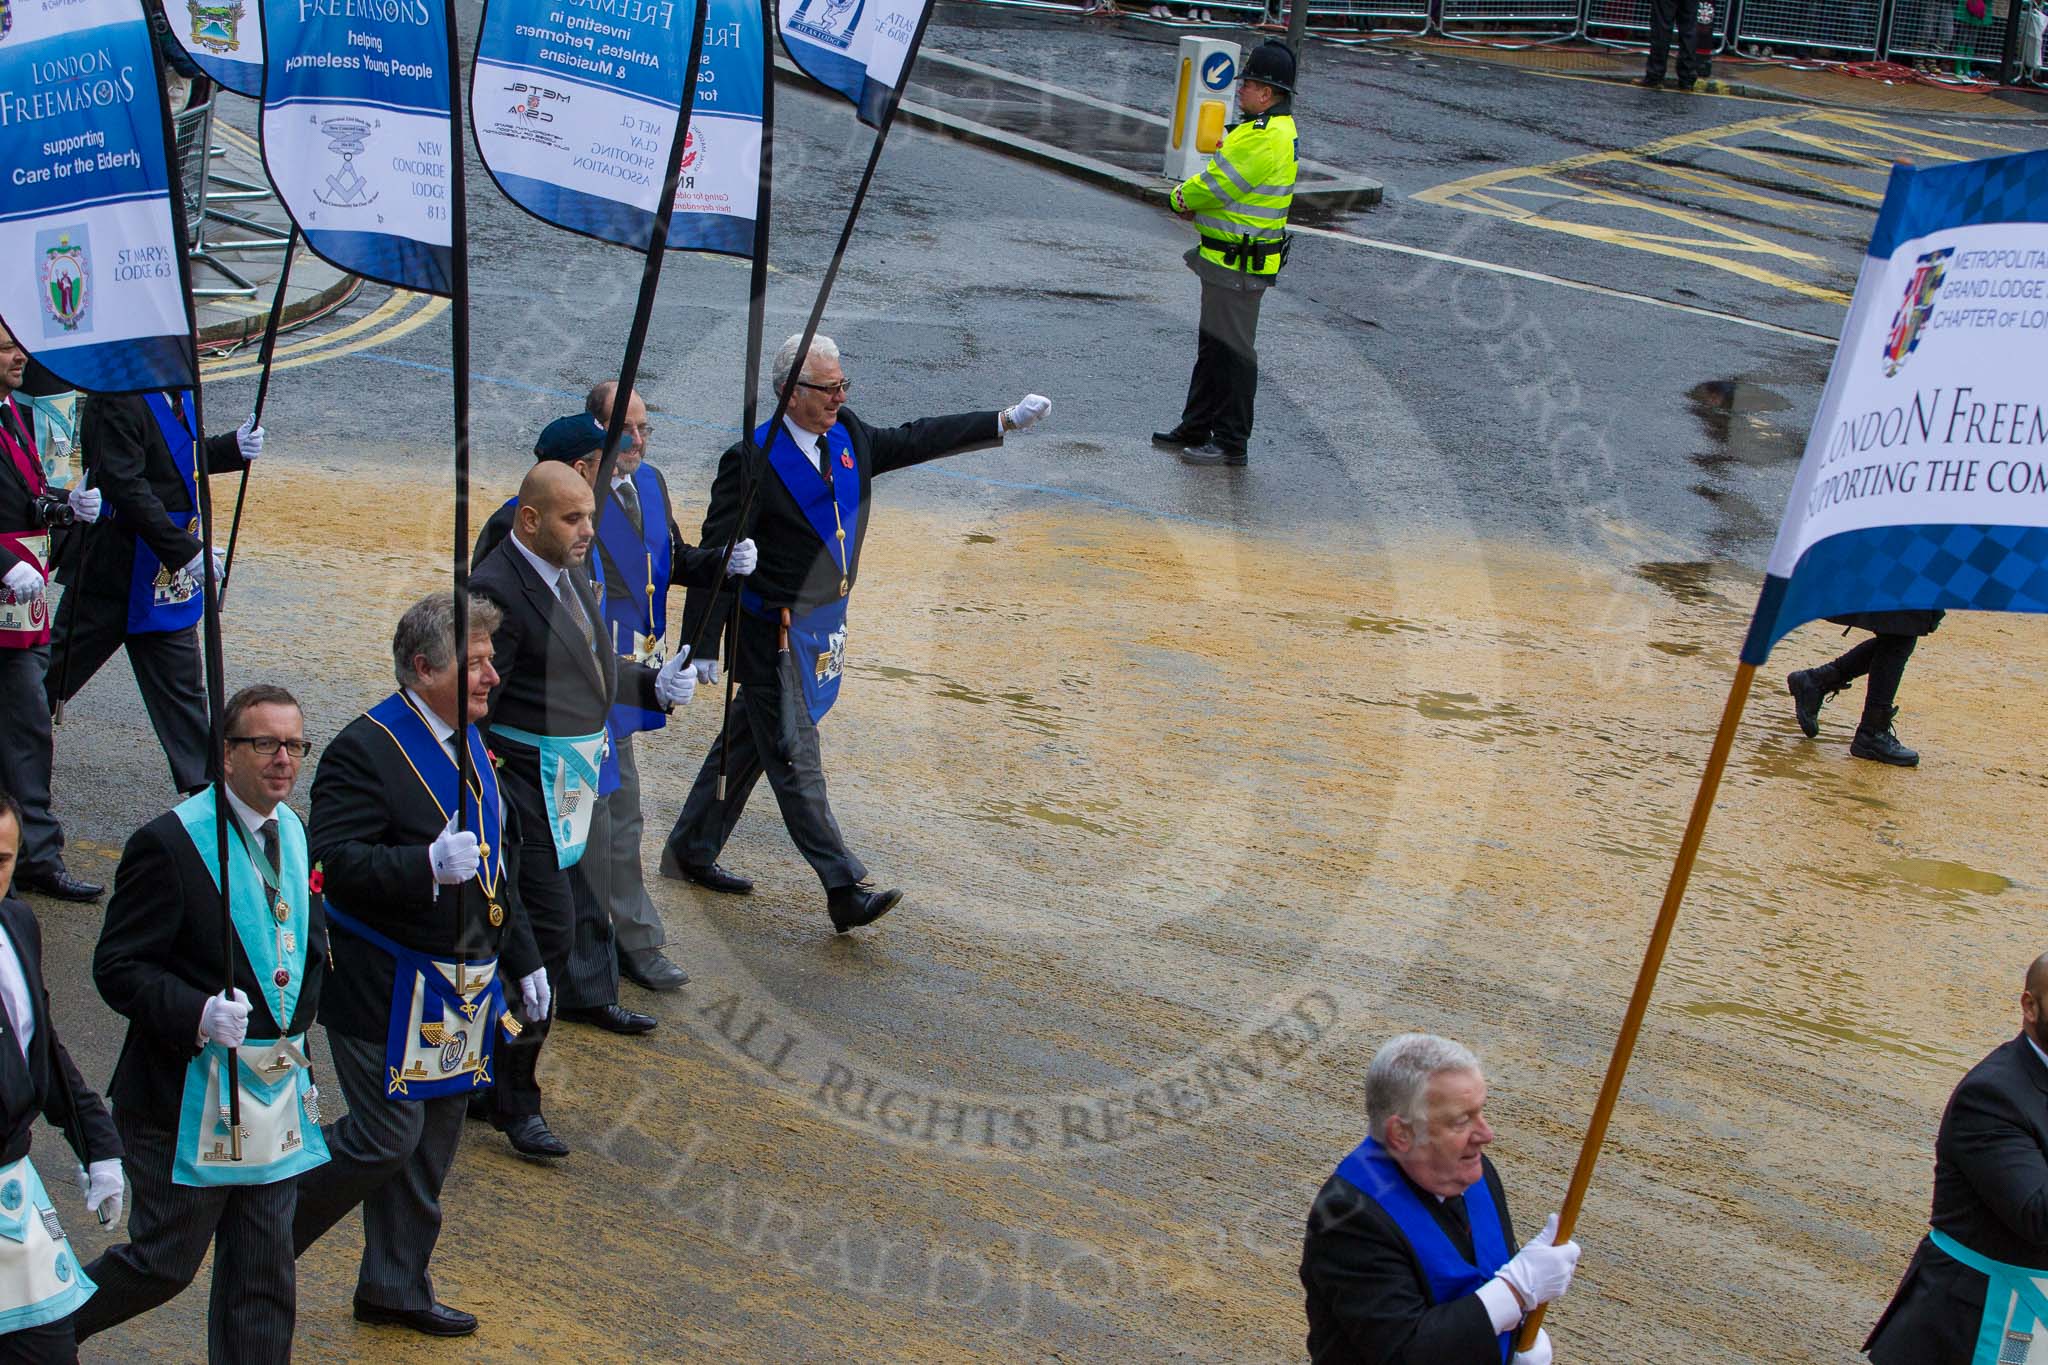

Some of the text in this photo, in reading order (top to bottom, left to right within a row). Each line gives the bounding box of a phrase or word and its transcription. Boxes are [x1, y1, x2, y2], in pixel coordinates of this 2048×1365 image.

[886, 12, 915, 32] ATLAS
[348, 30, 383, 53] helping
[32, 48, 113, 85] LONDON
[286, 52, 433, 80] Homeless Young People
[0, 66, 134, 126] FREEMASONS
[43, 130, 105, 156] supporting
[418, 142, 443, 157] NEW
[12, 149, 141, 185] Care for the Elderly
[393, 158, 446, 178] CONCORDE
[412, 182, 446, 199] LODGE
[428, 206, 446, 220] 813
[1955, 250, 2048, 269] METROPOLITA
[115, 263, 171, 281] LODGE 63
[1943, 280, 2046, 299] GRAND LODGE
[1934, 309, 1997, 328] CHAPTER
[1926, 460, 1980, 492] THE
